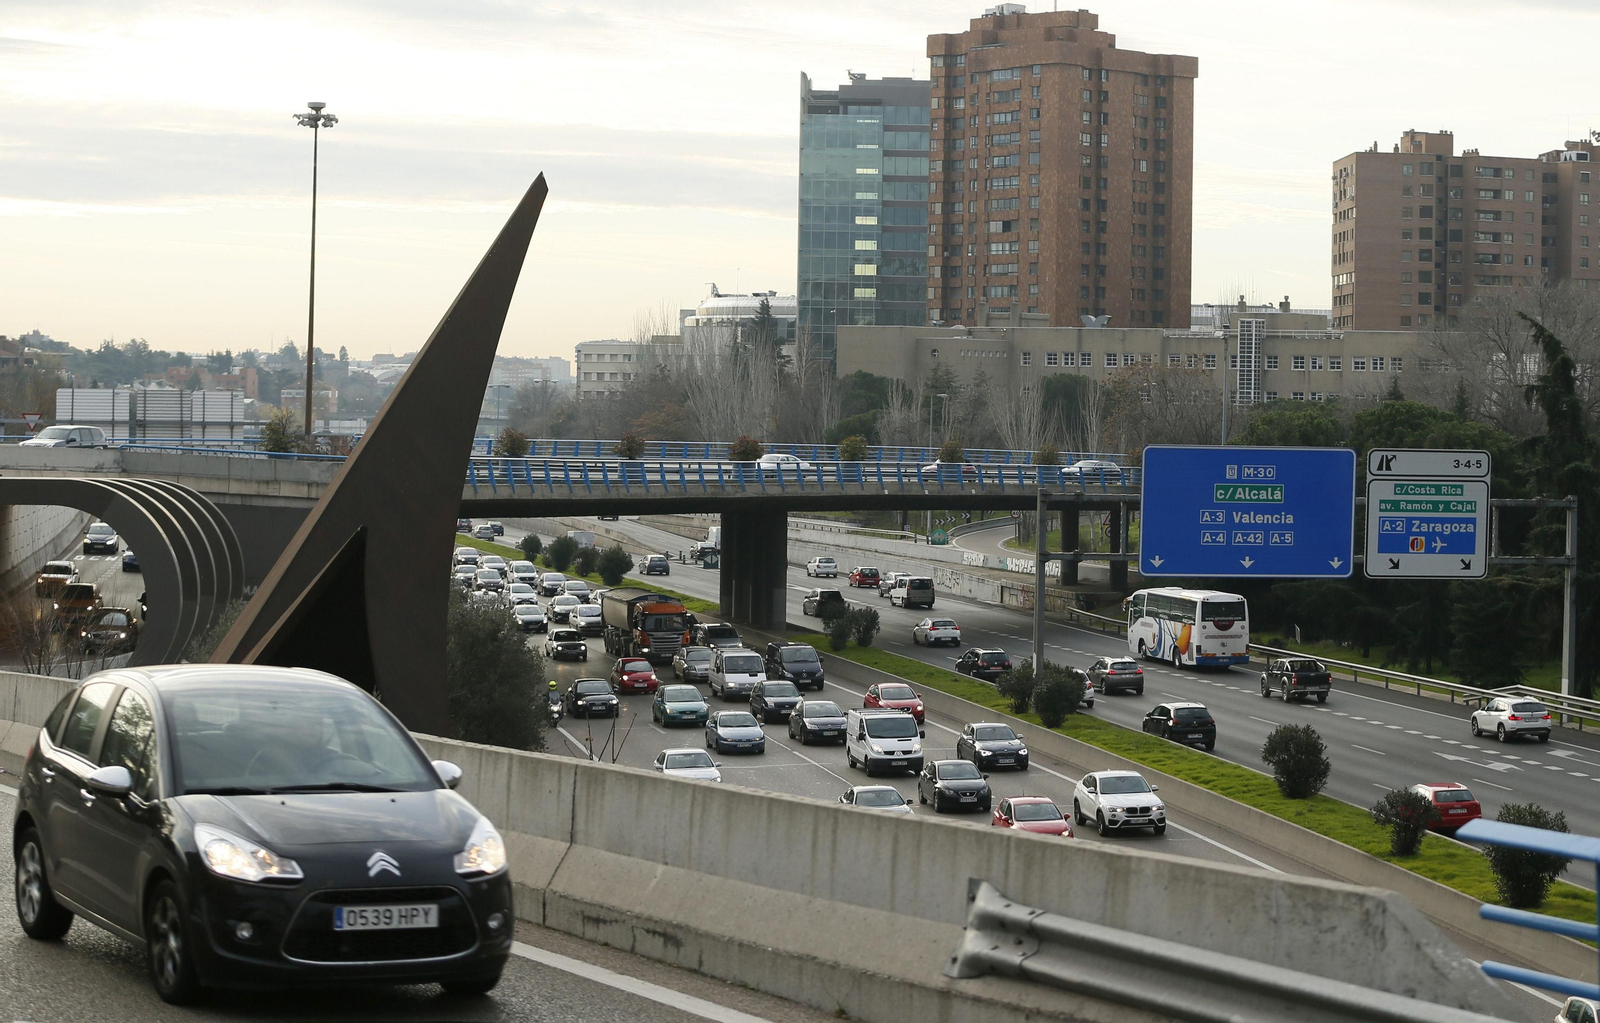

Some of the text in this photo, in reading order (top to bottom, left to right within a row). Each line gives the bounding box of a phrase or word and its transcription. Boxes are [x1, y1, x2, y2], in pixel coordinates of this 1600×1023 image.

[1453, 459, 1482, 469] 3-4-5
[1244, 467, 1274, 478] M-30
[1216, 487, 1282, 500] c/Alcalá
[1395, 485, 1462, 495] c/Costa Rica
[1380, 501, 1476, 512] av. Ramón y Cajal
[1202, 511, 1294, 524] A-3 Valencia
[1382, 520, 1475, 535] A-2 Zaragoza
[1203, 532, 1224, 543] A-4
[1234, 532, 1262, 543] A-42
[1271, 533, 1292, 544] A-5
[346, 907, 432, 927] 0539 HPY
